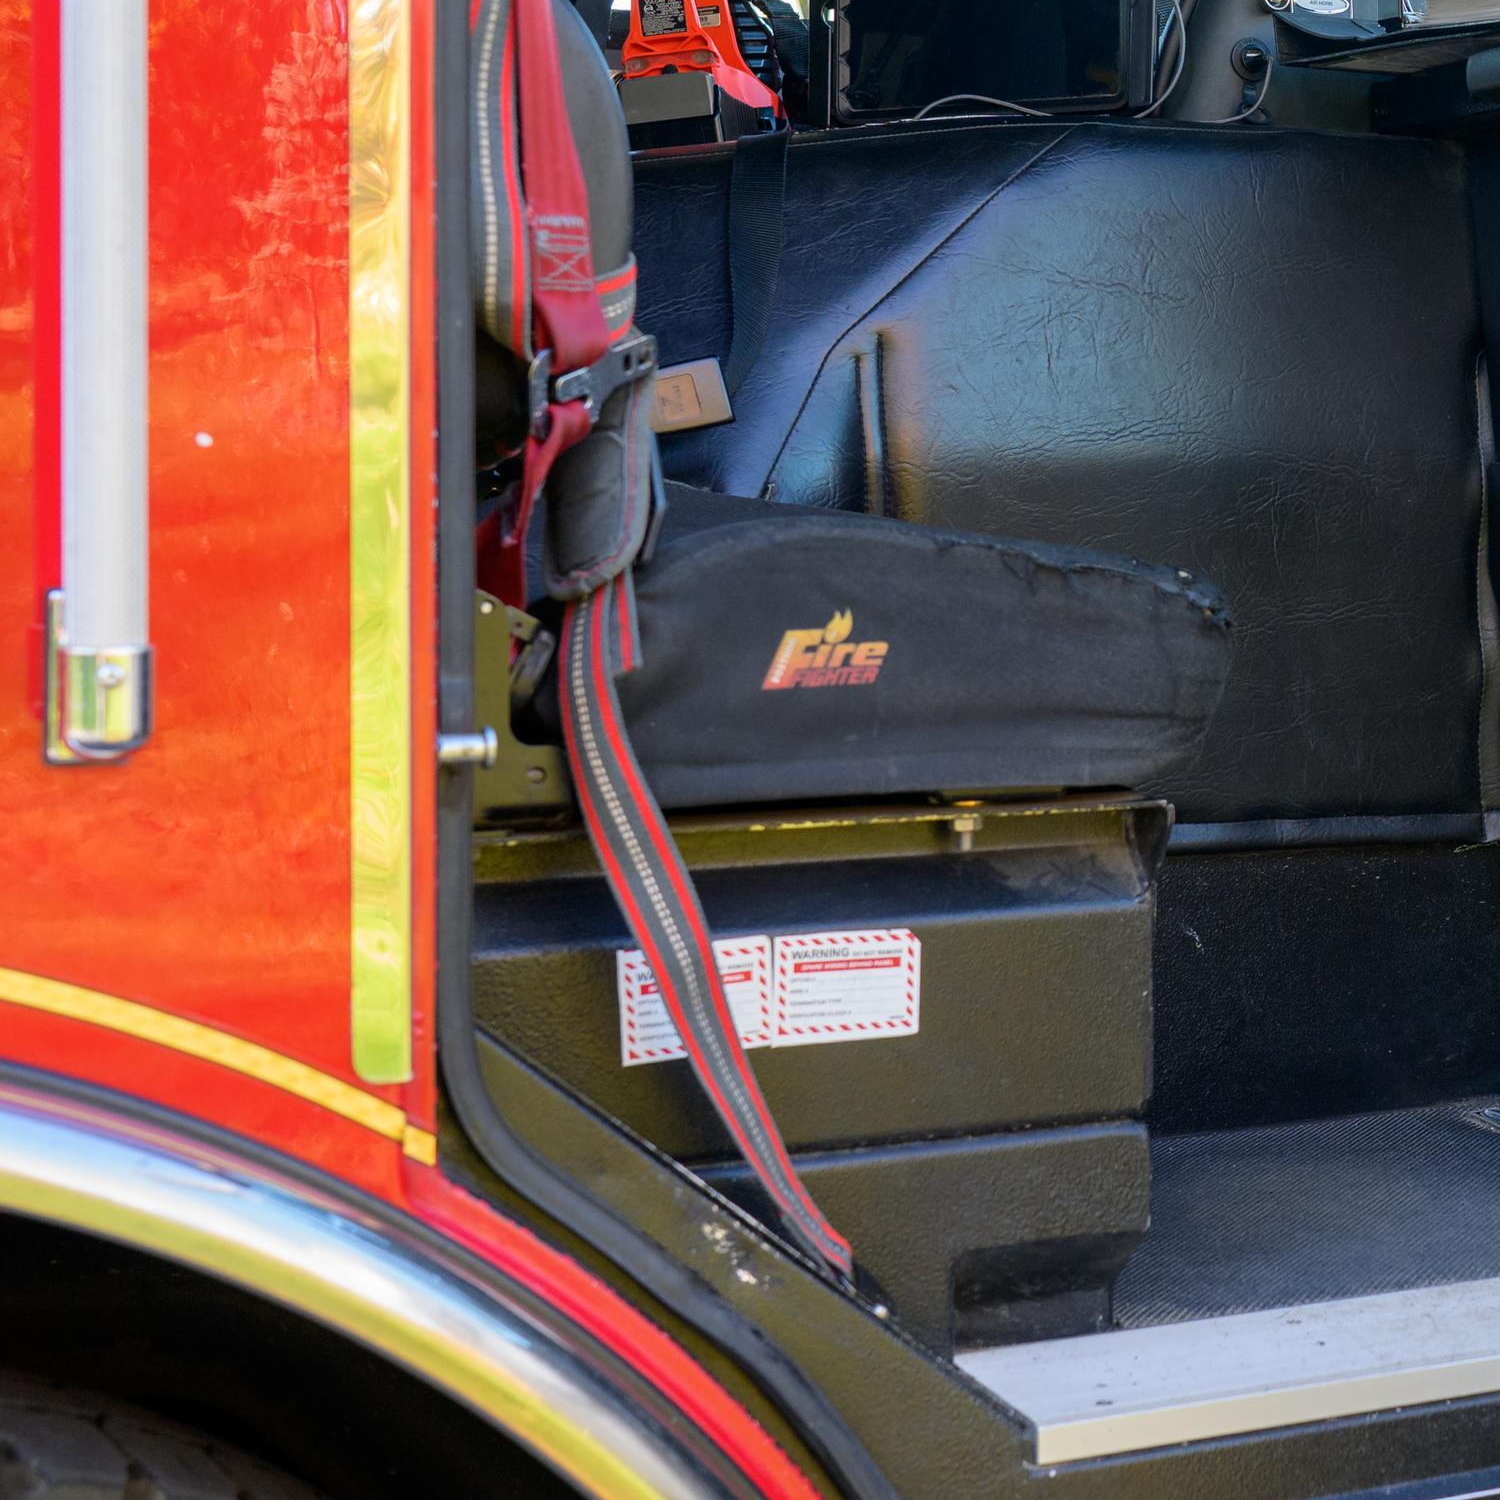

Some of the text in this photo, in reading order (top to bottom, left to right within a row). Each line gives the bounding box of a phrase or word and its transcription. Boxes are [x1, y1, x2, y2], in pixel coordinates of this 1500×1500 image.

[763, 608, 889, 690] Fire
[792, 665, 879, 688] FIGHTER
[791, 947, 849, 960] WARNING
